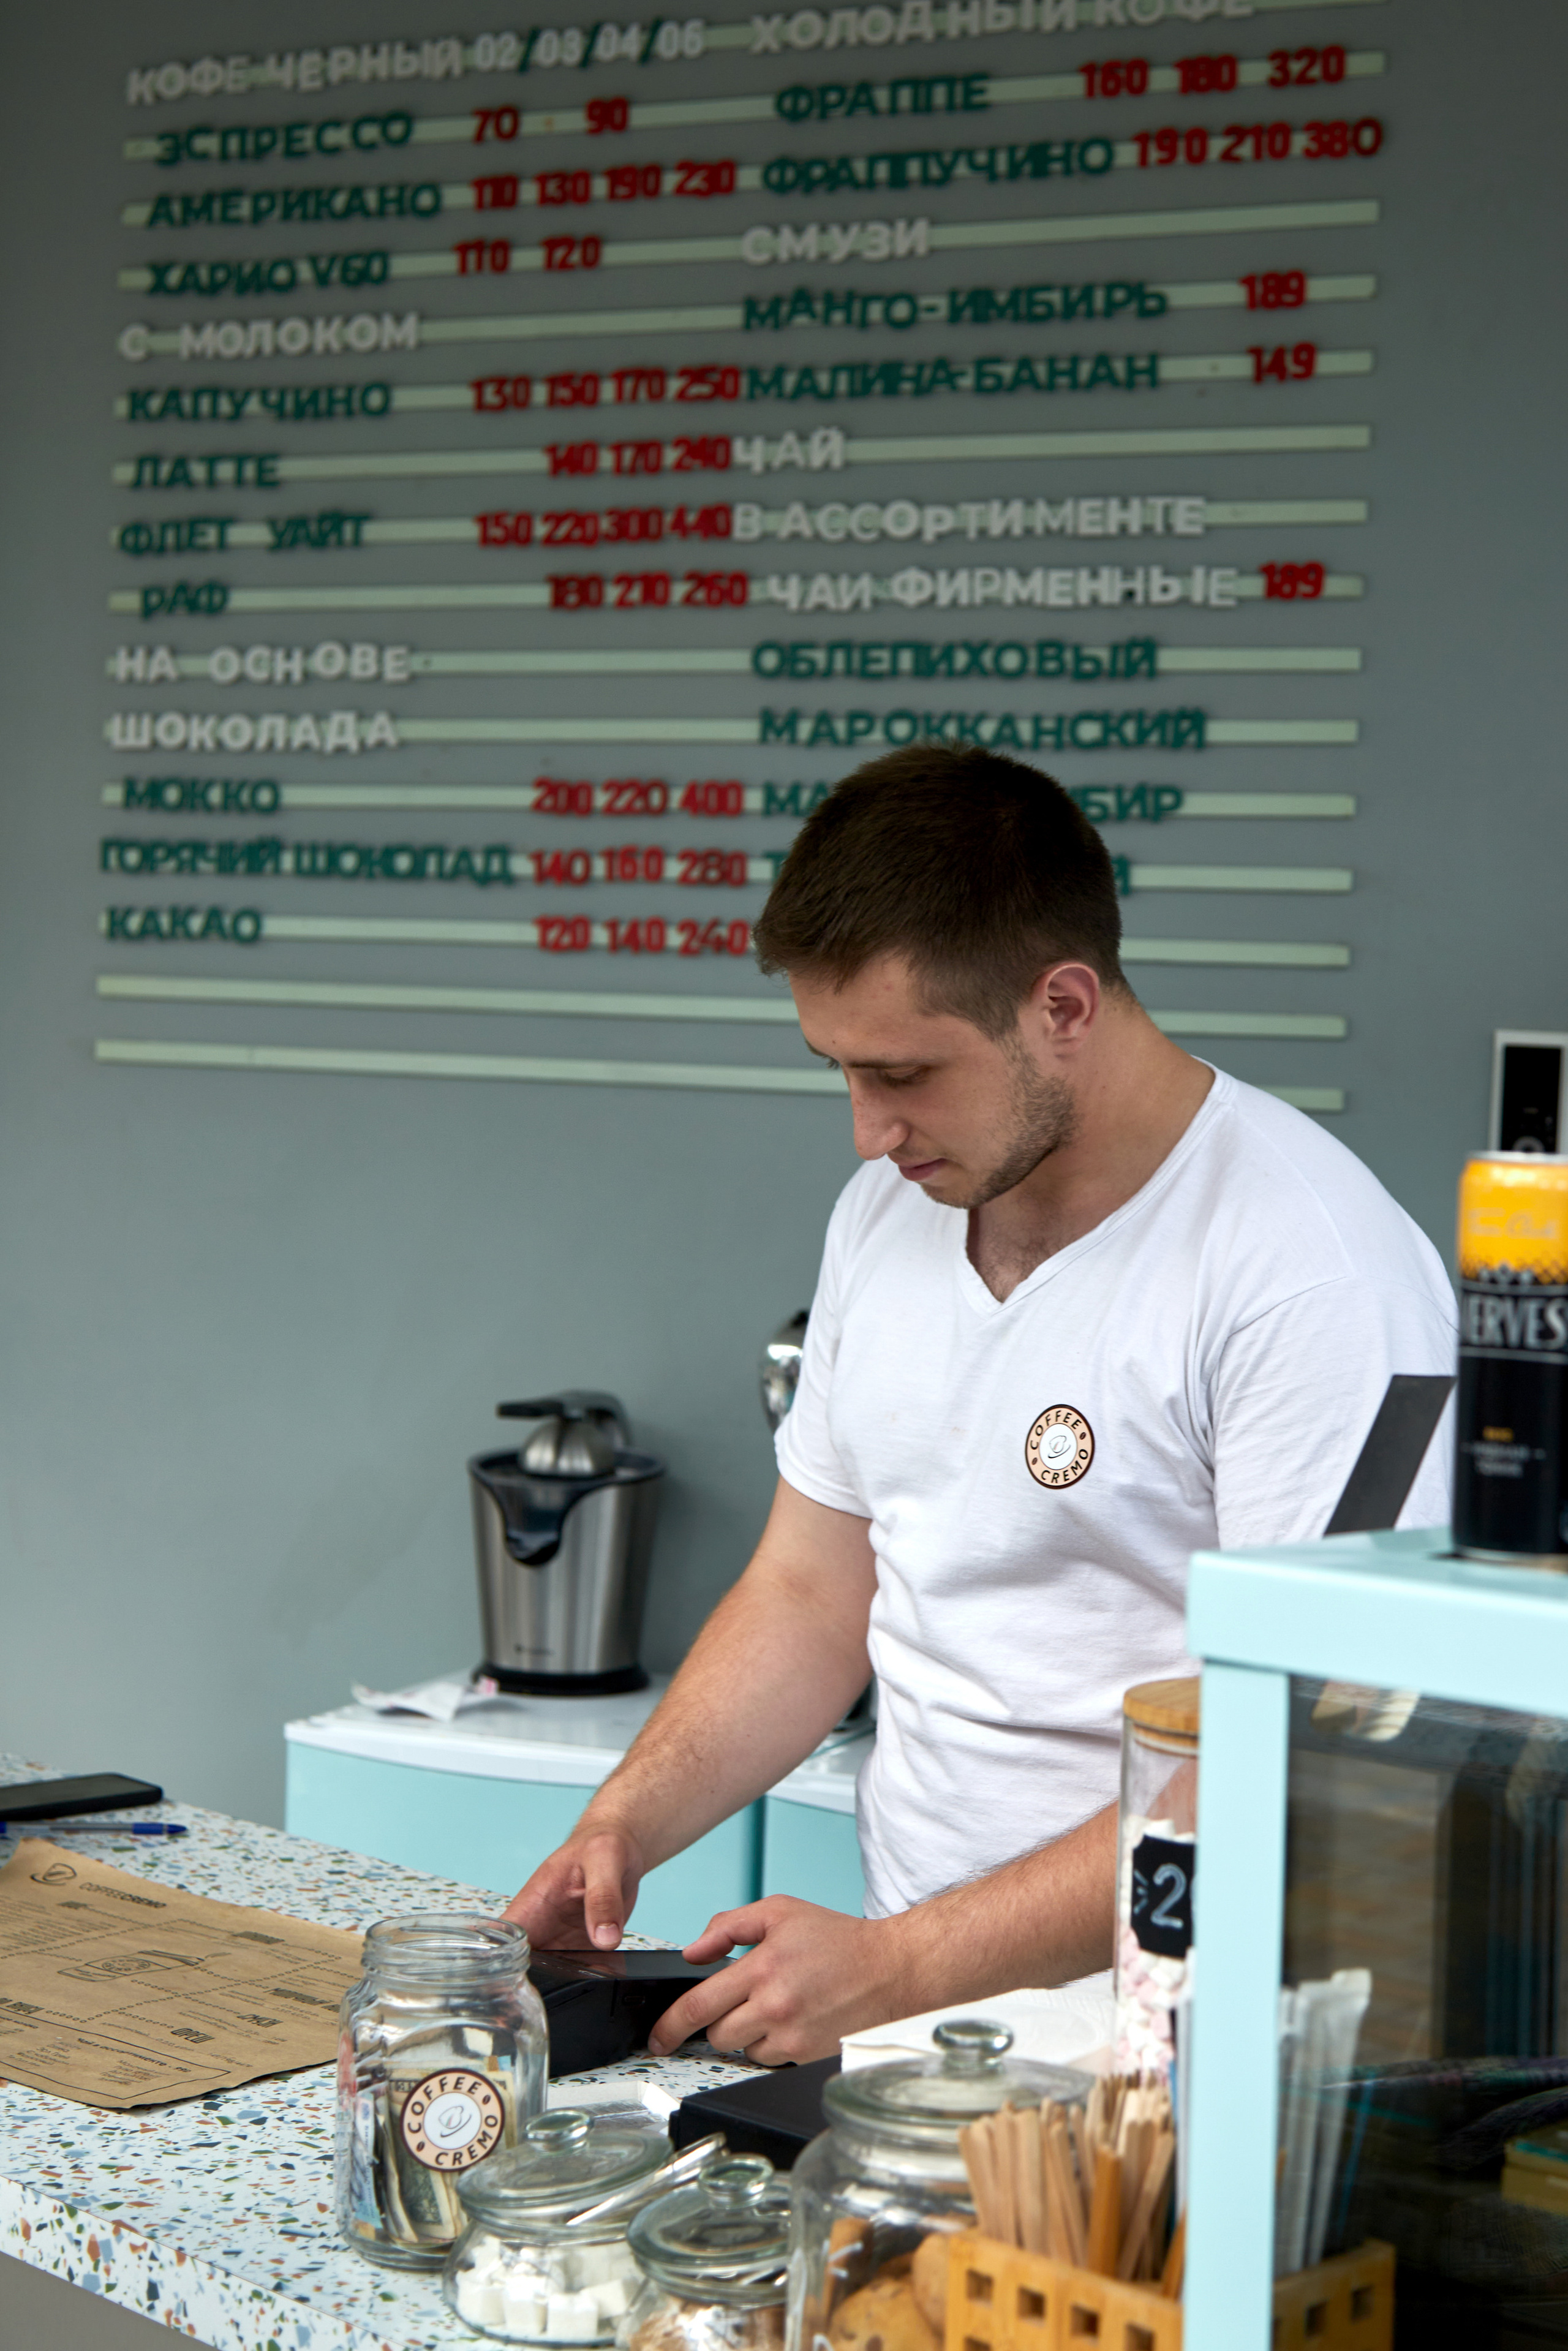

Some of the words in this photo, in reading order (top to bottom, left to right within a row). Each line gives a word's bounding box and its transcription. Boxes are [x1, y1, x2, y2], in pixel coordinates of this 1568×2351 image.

[750, 0, 1077, 55] ХОЛОДНЫЙ
[127, 54, 250, 107] КОФЕ
[267, 36, 464, 92] ЧЕРНЫЙ
[774, 72, 990, 122] ФРАППЕ
[1078, 58, 1150, 99] 160
[1173, 54, 1238, 94] 180
[1266, 45, 1346, 88] 320
[154, 110, 415, 166] ЭСПРЕССО
[472, 106, 520, 143] 70
[584, 96, 629, 135] 90
[762, 137, 1114, 195] ФРАППУЧИНО
[1131, 127, 1209, 168] 190
[1218, 122, 1292, 163] 210
[146, 183, 443, 229] АМЕРИКАНО
[471, 174, 519, 211] 110
[533, 170, 592, 206] 130
[602, 163, 663, 202] 190
[673, 158, 737, 198] 230
[145, 257, 297, 296] ХАРИО
[453, 238, 511, 275] 110
[540, 234, 603, 271] 120
[741, 217, 931, 266] СМУЗИ
[743, 281, 1169, 331] МАНГО-ИМБИРЬ
[1238, 269, 1306, 311] 189
[121, 322, 151, 361] С
[180, 311, 421, 361] МОЛОКОМ
[127, 382, 393, 423] КАПУЧИНО
[470, 375, 532, 413] 130
[544, 371, 601, 408] 150
[609, 367, 668, 403] 170
[675, 364, 741, 402] 250
[746, 351, 1160, 401] МАЛИНА-БАНАН
[1246, 341, 1317, 385] 149
[131, 453, 282, 489] ЛАТТЕ
[543, 440, 600, 478] 140
[608, 438, 664, 476] 170
[671, 434, 732, 471] 240
[734, 427, 844, 475] ЧАЙ
[119, 515, 236, 556] ФЛЕТ
[265, 508, 375, 552] УАЙТ
[473, 511, 533, 546] 150
[540, 509, 600, 546] 220
[603, 506, 665, 542] 300
[669, 503, 733, 542] 440
[735, 502, 762, 540] В
[777, 497, 1207, 543] АССОРТИМЕНТЕ
[140, 578, 230, 621] РАФ
[546, 573, 605, 611] 180
[612, 570, 670, 608] 210
[682, 569, 749, 608] 260
[767, 571, 874, 612] ЧАИ
[891, 564, 1240, 608] ФИРМЕННЫЕ
[1258, 560, 1325, 600] 189
[115, 644, 179, 684] НА
[209, 639, 412, 683] ОСНОВЕ
[751, 635, 1159, 681] ОБЛЕПИХОВЫЙ
[110, 709, 402, 755] ШОКОЛАДА
[757, 706, 1208, 751] МАРОККАНСКИЙ
[121, 775, 282, 815] МОККО
[532, 777, 595, 817] 200
[600, 777, 669, 817] 220
[678, 779, 744, 817] 400
[101, 835, 284, 875] ГОРЯЧИЙ
[527, 848, 591, 886] 140
[598, 845, 665, 882] 160
[676, 848, 748, 887] 280
[105, 905, 264, 945] КАКАО
[532, 915, 591, 953] 120
[603, 917, 666, 954] 140
[676, 918, 749, 956] 240
[1461, 1291, 1568, 1349] ERVES
[1030, 1409, 1082, 1450] COFFEE
[1041, 1449, 1089, 1484] CREMO
[1150, 1863, 1194, 1929] 2
[170, 2028, 215, 2044] ФРЕШ
[408, 2075, 482, 2134] COFFEE
[434, 2115, 499, 2167] CREMO
